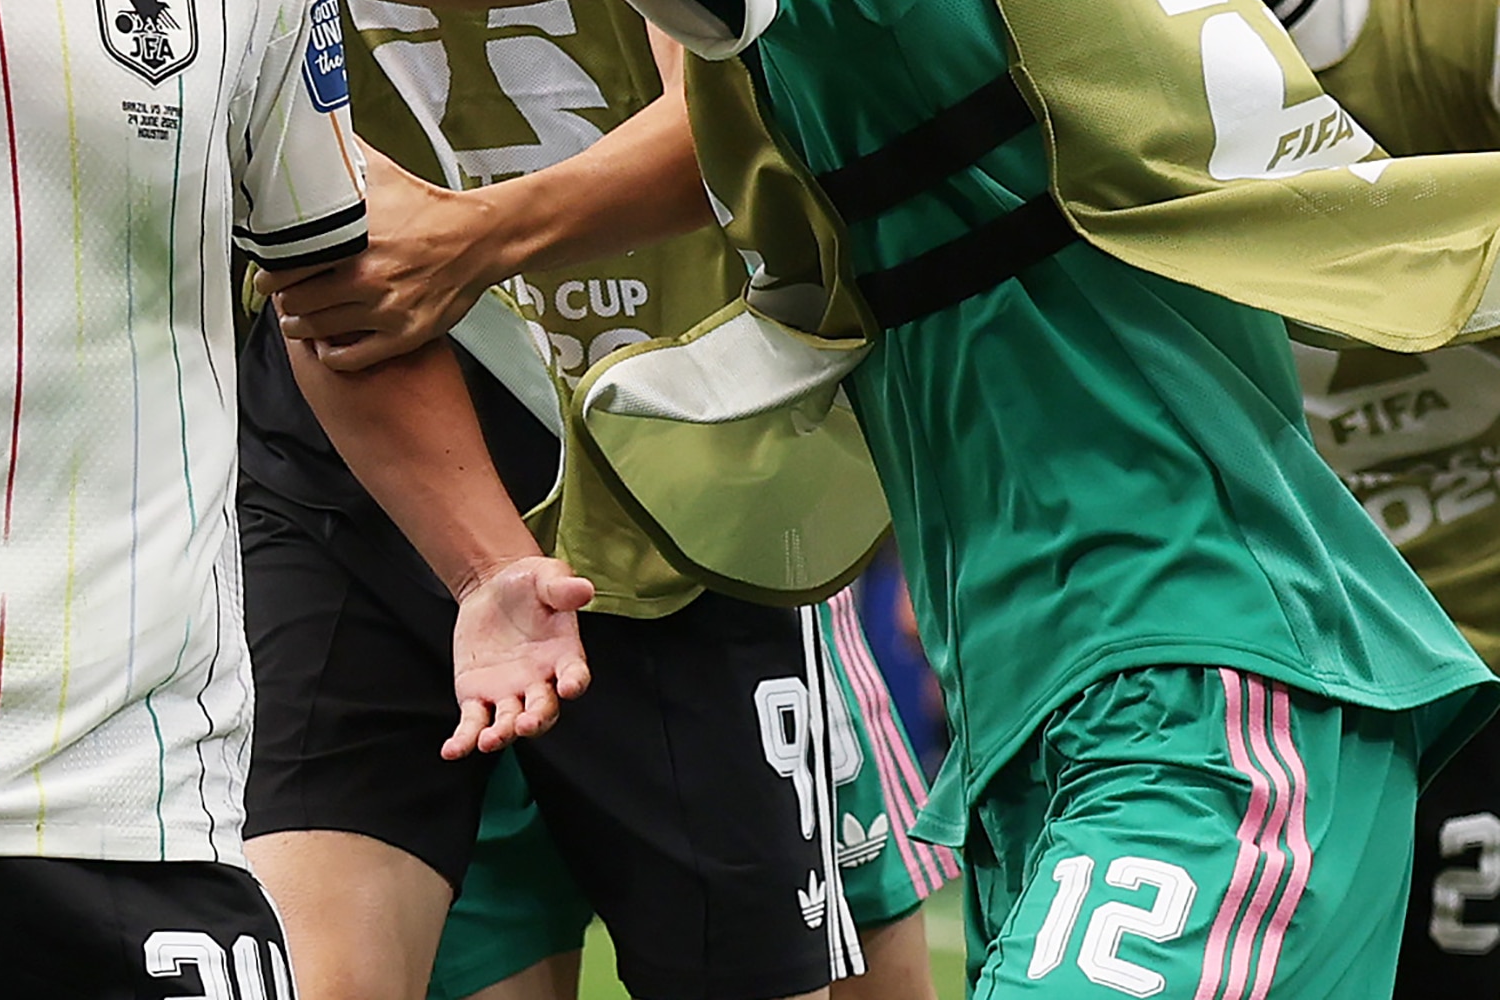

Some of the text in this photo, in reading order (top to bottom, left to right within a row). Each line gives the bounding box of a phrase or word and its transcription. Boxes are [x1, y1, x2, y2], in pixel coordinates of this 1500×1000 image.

[129, 36, 175, 60] JFA
[314, 50, 344, 75] the
[1266, 109, 1354, 172] FIFA
[555, 279, 648, 320] CUP
[1329, 389, 1449, 446] FIFA
[1363, 466, 1500, 547] 02
[1027, 854, 1197, 998] 12
